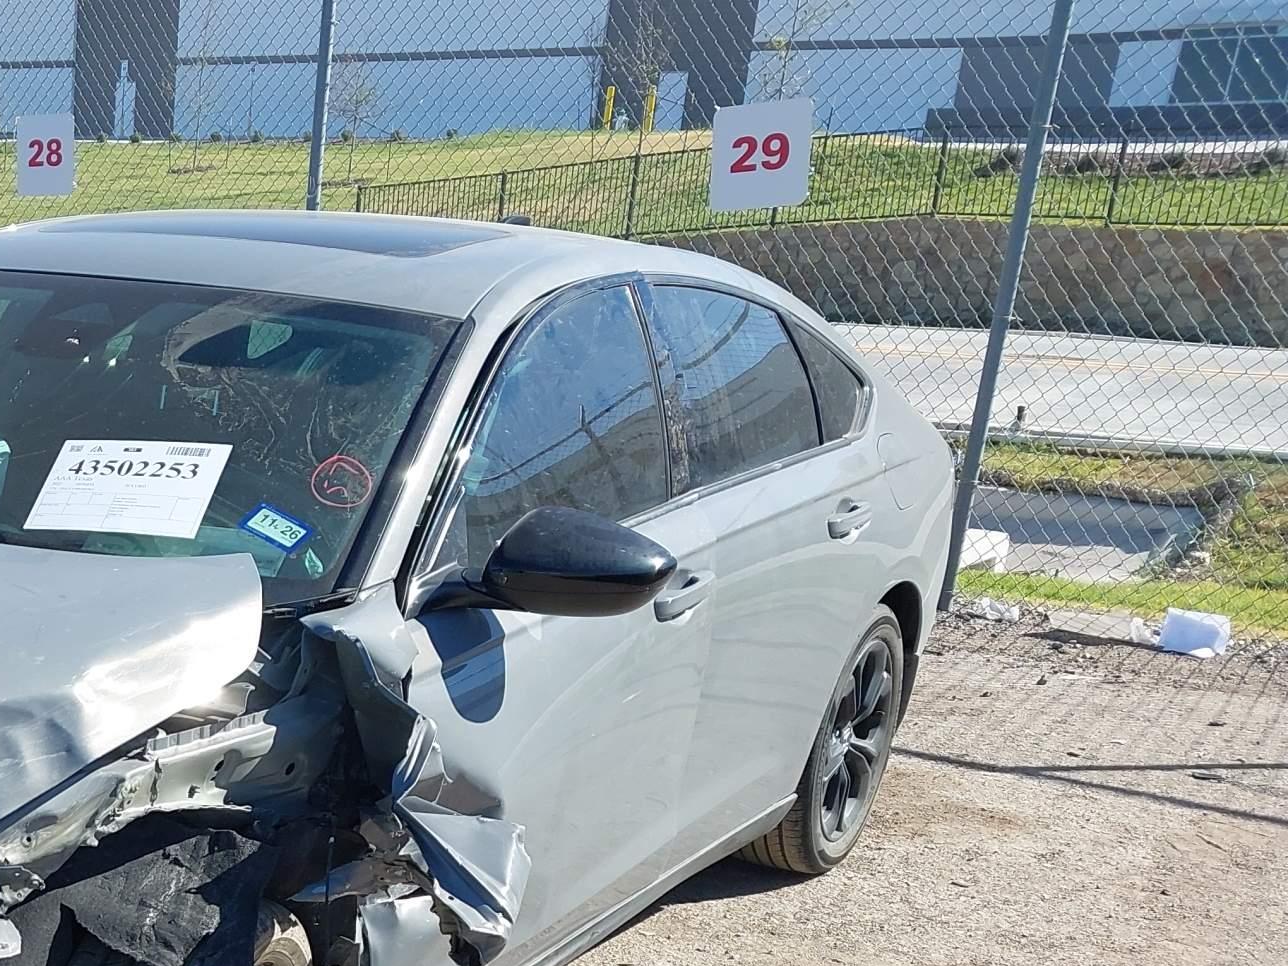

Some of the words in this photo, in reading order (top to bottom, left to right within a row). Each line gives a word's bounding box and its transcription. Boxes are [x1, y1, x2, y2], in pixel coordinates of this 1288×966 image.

[28, 138, 63, 168] 28
[729, 132, 790, 174] 29
[68, 459, 200, 480] 43502253
[279, 525, 302, 540] 26
